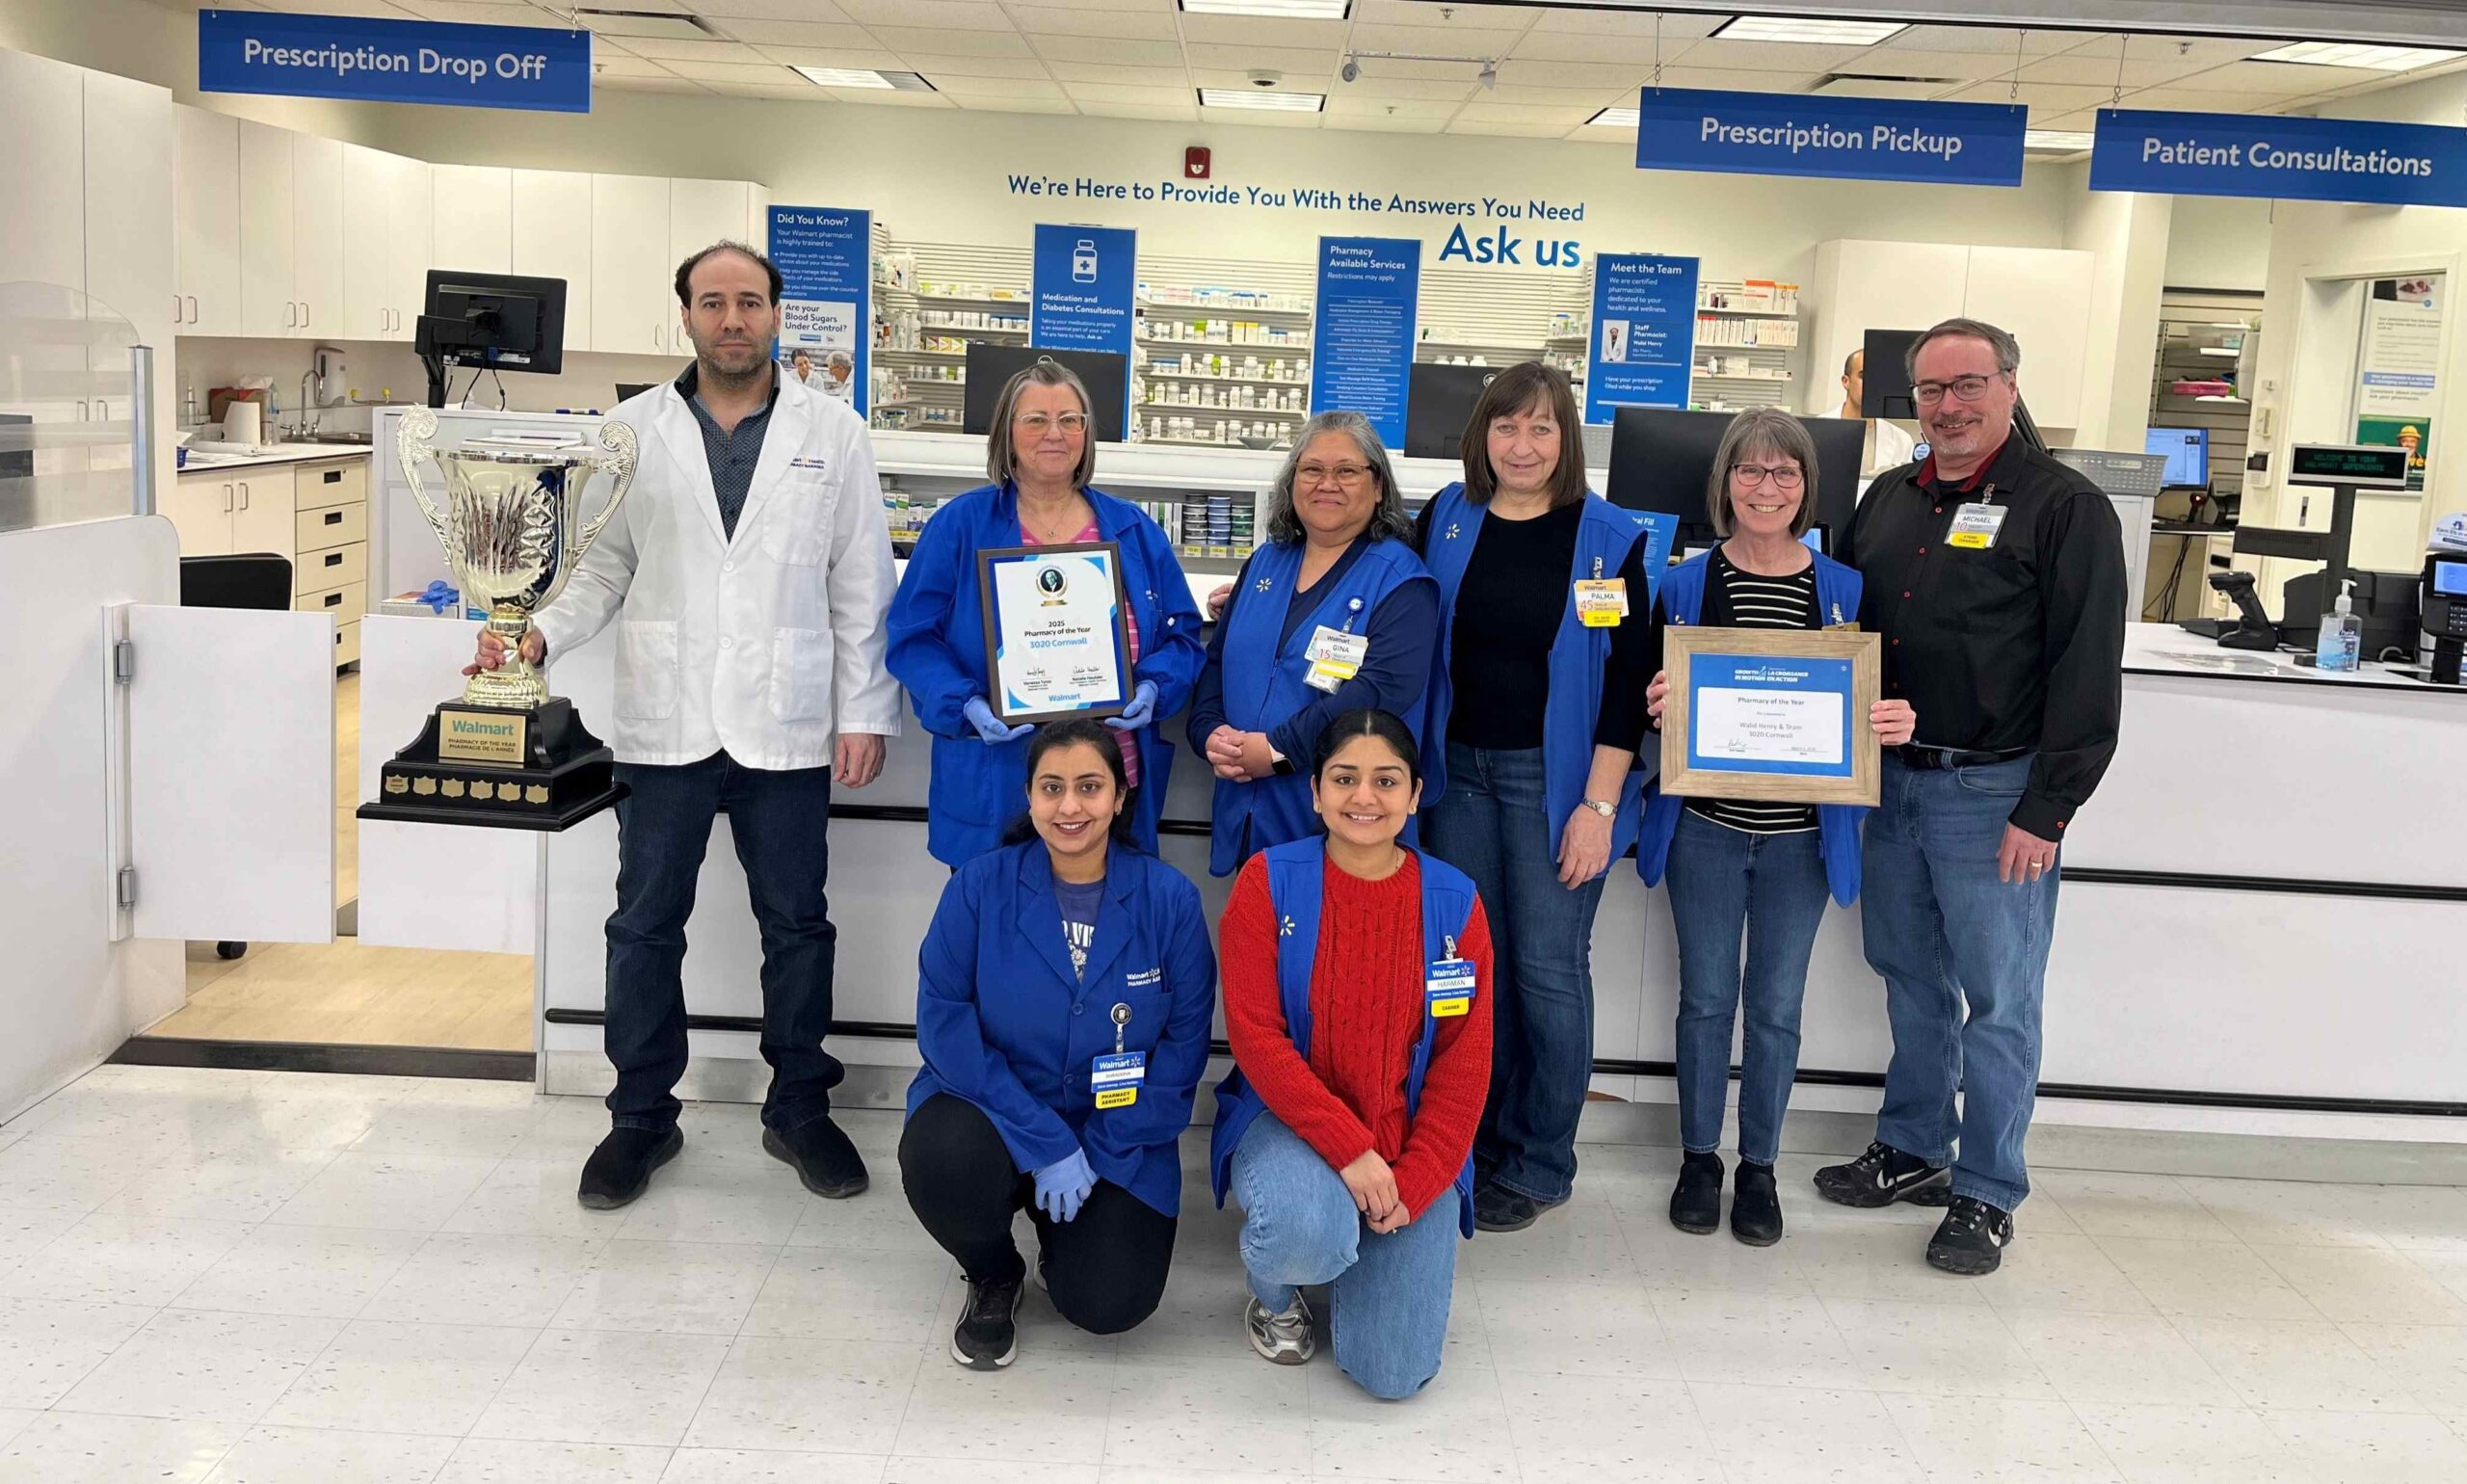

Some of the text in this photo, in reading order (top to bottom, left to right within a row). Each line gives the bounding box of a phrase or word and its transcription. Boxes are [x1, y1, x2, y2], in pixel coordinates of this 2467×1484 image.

[245, 39, 547, 83] Prescription Drop Off
[1700, 117, 1963, 161] Prescription Pickup
[2142, 137, 2432, 176] Patient Consultations
[1075, 178, 1127, 199] Here
[1132, 183, 1154, 200] to
[1161, 182, 1240, 204] Provide
[1247, 186, 1286, 207] You
[1292, 189, 1341, 210] With
[1348, 192, 1382, 212] the
[1388, 194, 1475, 216] Answers
[1482, 198, 1522, 219] You
[1528, 200, 1584, 222] Need
[777, 214, 849, 226] Did You Know?
[783, 238, 801, 247] highly
[1439, 223, 1580, 268] Ask us
[1330, 246, 1373, 257] Pharmacy
[1329, 258, 1406, 270] Available Services
[1610, 262, 1682, 275] Meet the Team
[1327, 272, 1364, 280] Restrictions
[1042, 293, 1082, 303] Medication
[785, 303, 820, 313] Are your
[1042, 304, 1125, 315] Diabetes Consultations
[785, 312, 837, 324] Blood Sugars
[785, 322, 847, 332] Under Control?
[1956, 521, 1968, 531] 10
[1580, 599, 1593, 610] 45
[1048, 620, 1066, 628] 2025
[1024, 628, 1056, 637] Pharmacy
[1029, 637, 1088, 649] 3020 Cornwall
[1327, 634, 1350, 644] Walmart
[1319, 648, 1331, 660] 15
[1332, 644, 1349, 653] GINA
[1048, 693, 1080, 702] Walmart
[1738, 697, 1769, 705] Pharmacy
[452, 720, 515, 736] Walmart
[1127, 971, 1149, 980] Walmart
[1432, 967, 1460, 978] Walmart
[1100, 1060, 1130, 1070] Walmart
[1101, 1091, 1130, 1100] PHARMACY
